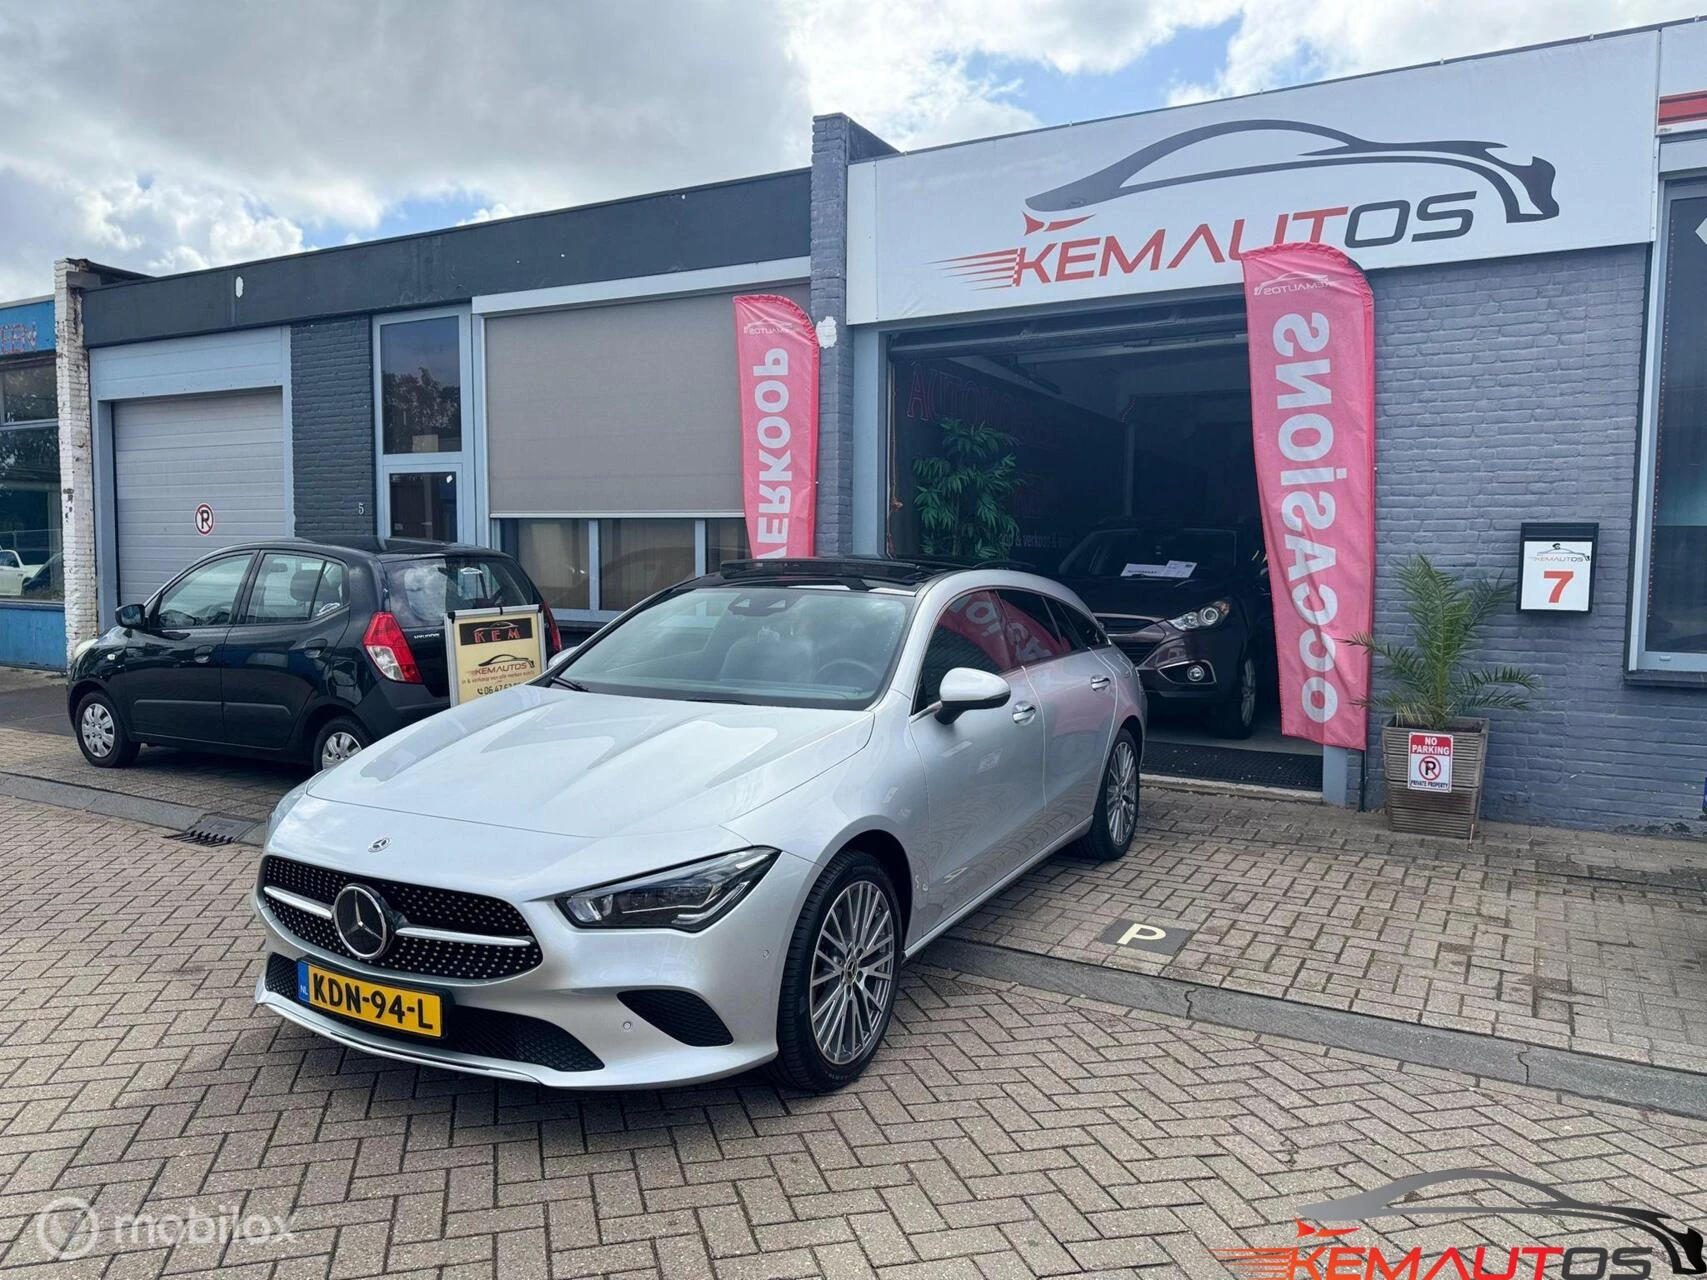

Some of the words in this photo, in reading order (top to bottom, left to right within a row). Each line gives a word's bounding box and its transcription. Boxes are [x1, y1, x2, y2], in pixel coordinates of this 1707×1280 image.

[1012, 190, 1477, 287] KEMAUTOS
[358, 502, 365, 515] 5
[1543, 570, 1574, 604] 7
[474, 629, 521, 643] KEM
[474, 663, 527, 676] KEMAUTOS
[1424, 736, 1438, 746] NO
[1411, 745, 1450, 755] PARKING
[313, 972, 434, 1030] KDN-94-L
